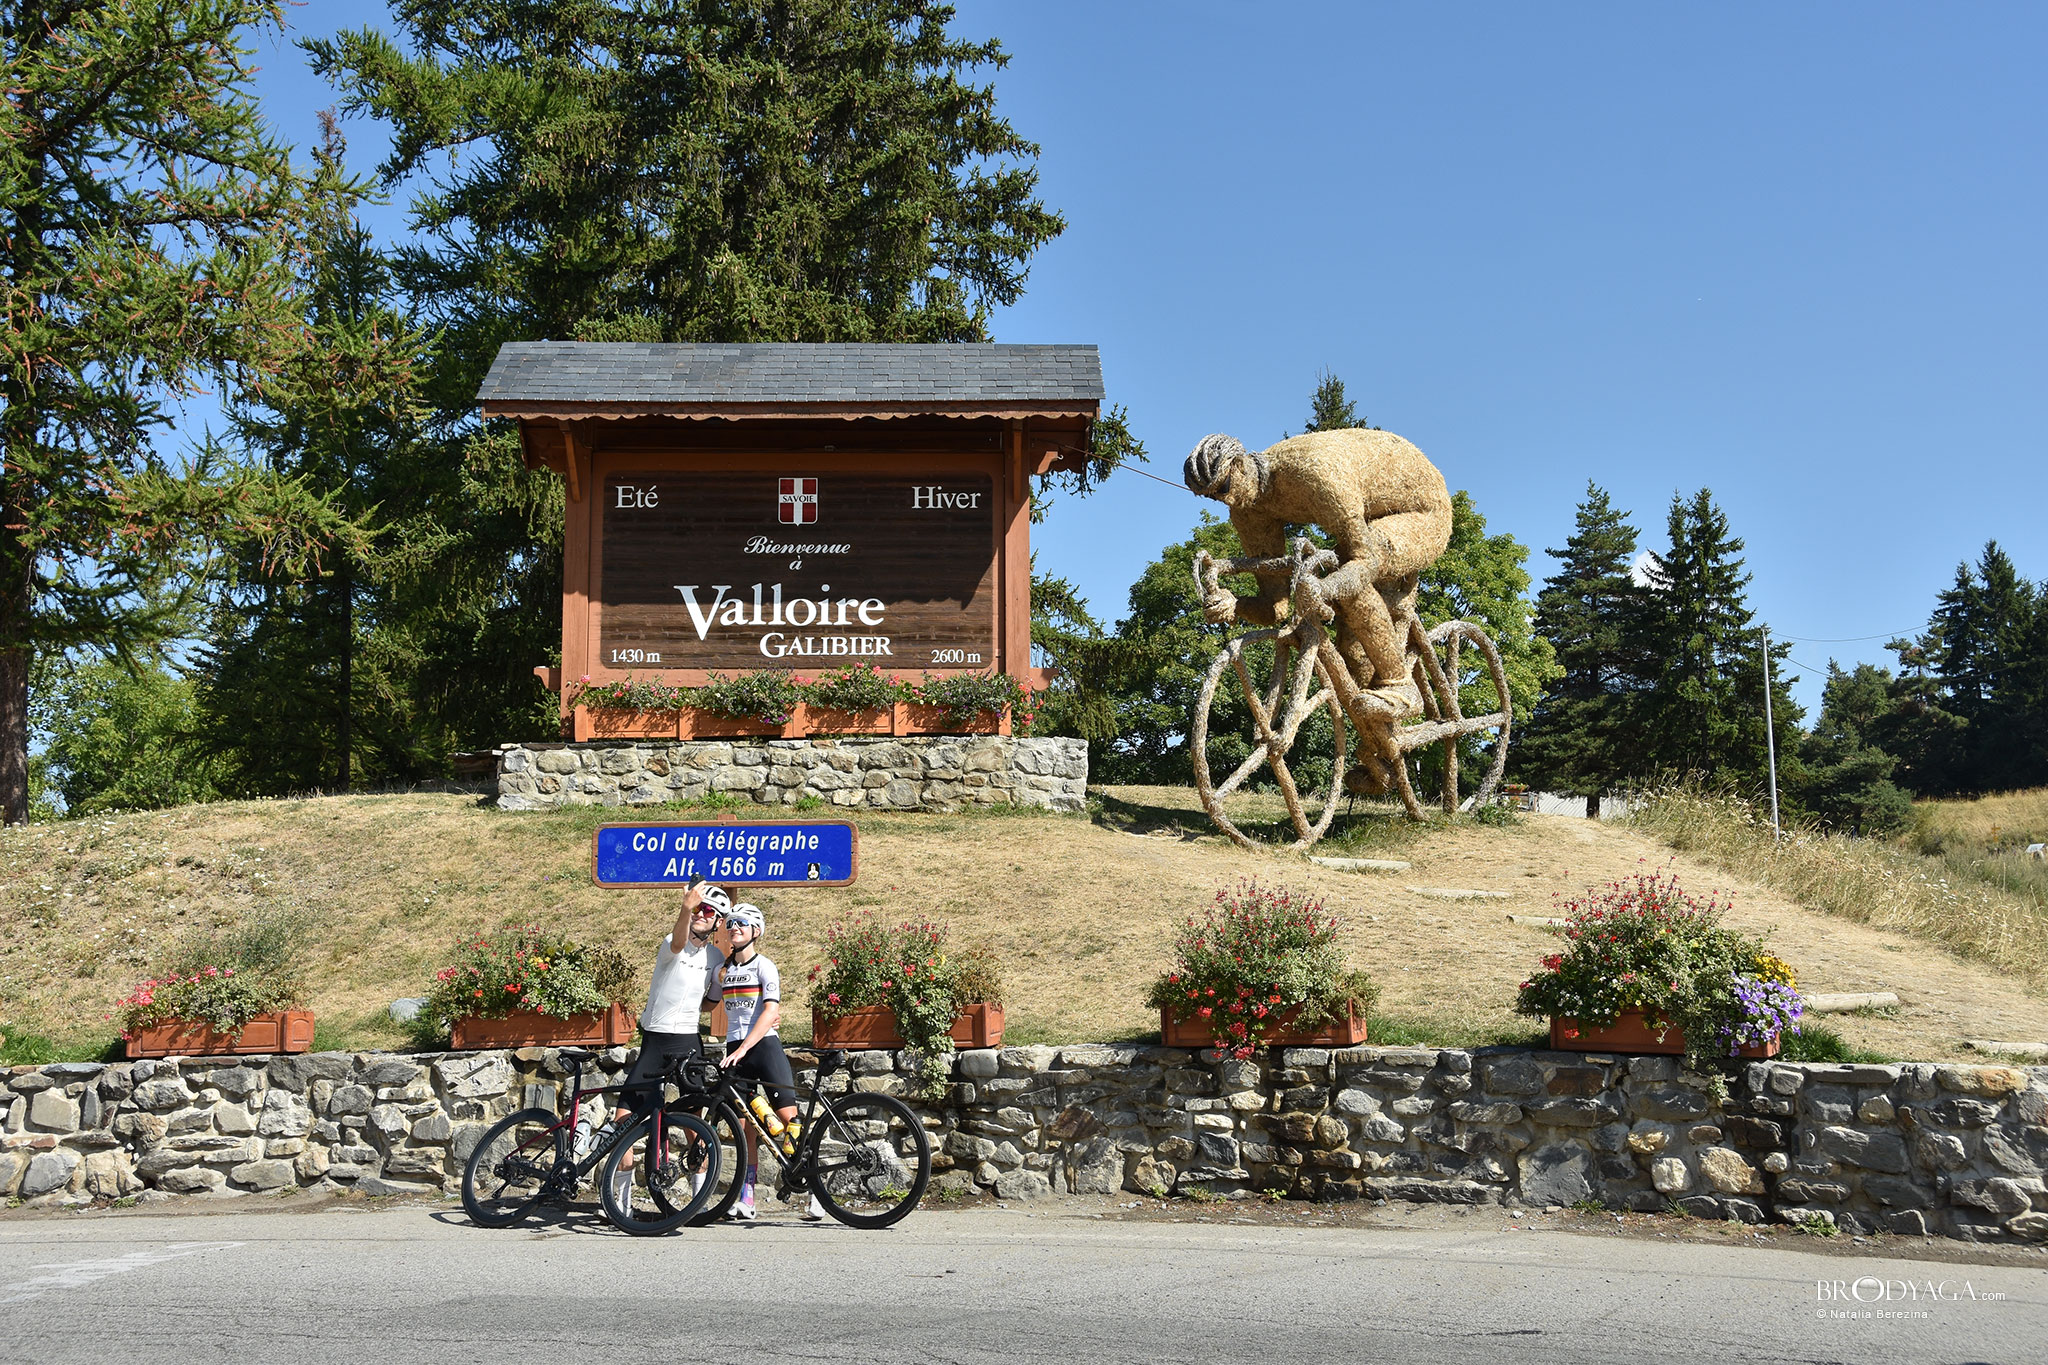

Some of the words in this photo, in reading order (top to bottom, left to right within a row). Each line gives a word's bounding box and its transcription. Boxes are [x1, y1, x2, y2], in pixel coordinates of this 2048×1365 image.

[615, 485, 658, 509] Eté
[911, 485, 981, 509] Hiver
[744, 535, 851, 555] Bienvenue
[789, 555, 803, 571] à
[673, 583, 885, 641] Valloire
[611, 649, 643, 663] 1430
[646, 652, 662, 663] m
[760, 633, 893, 657] GALIBIER
[931, 649, 964, 663] 2600
[967, 652, 982, 663] m
[632, 832, 667, 852] Col
[674, 833, 699, 852] du
[707, 830, 819, 855] télégraphe
[708, 857, 756, 876] 1566
[767, 863, 785, 876] m
[585, 1112, 639, 1165] cannondale
